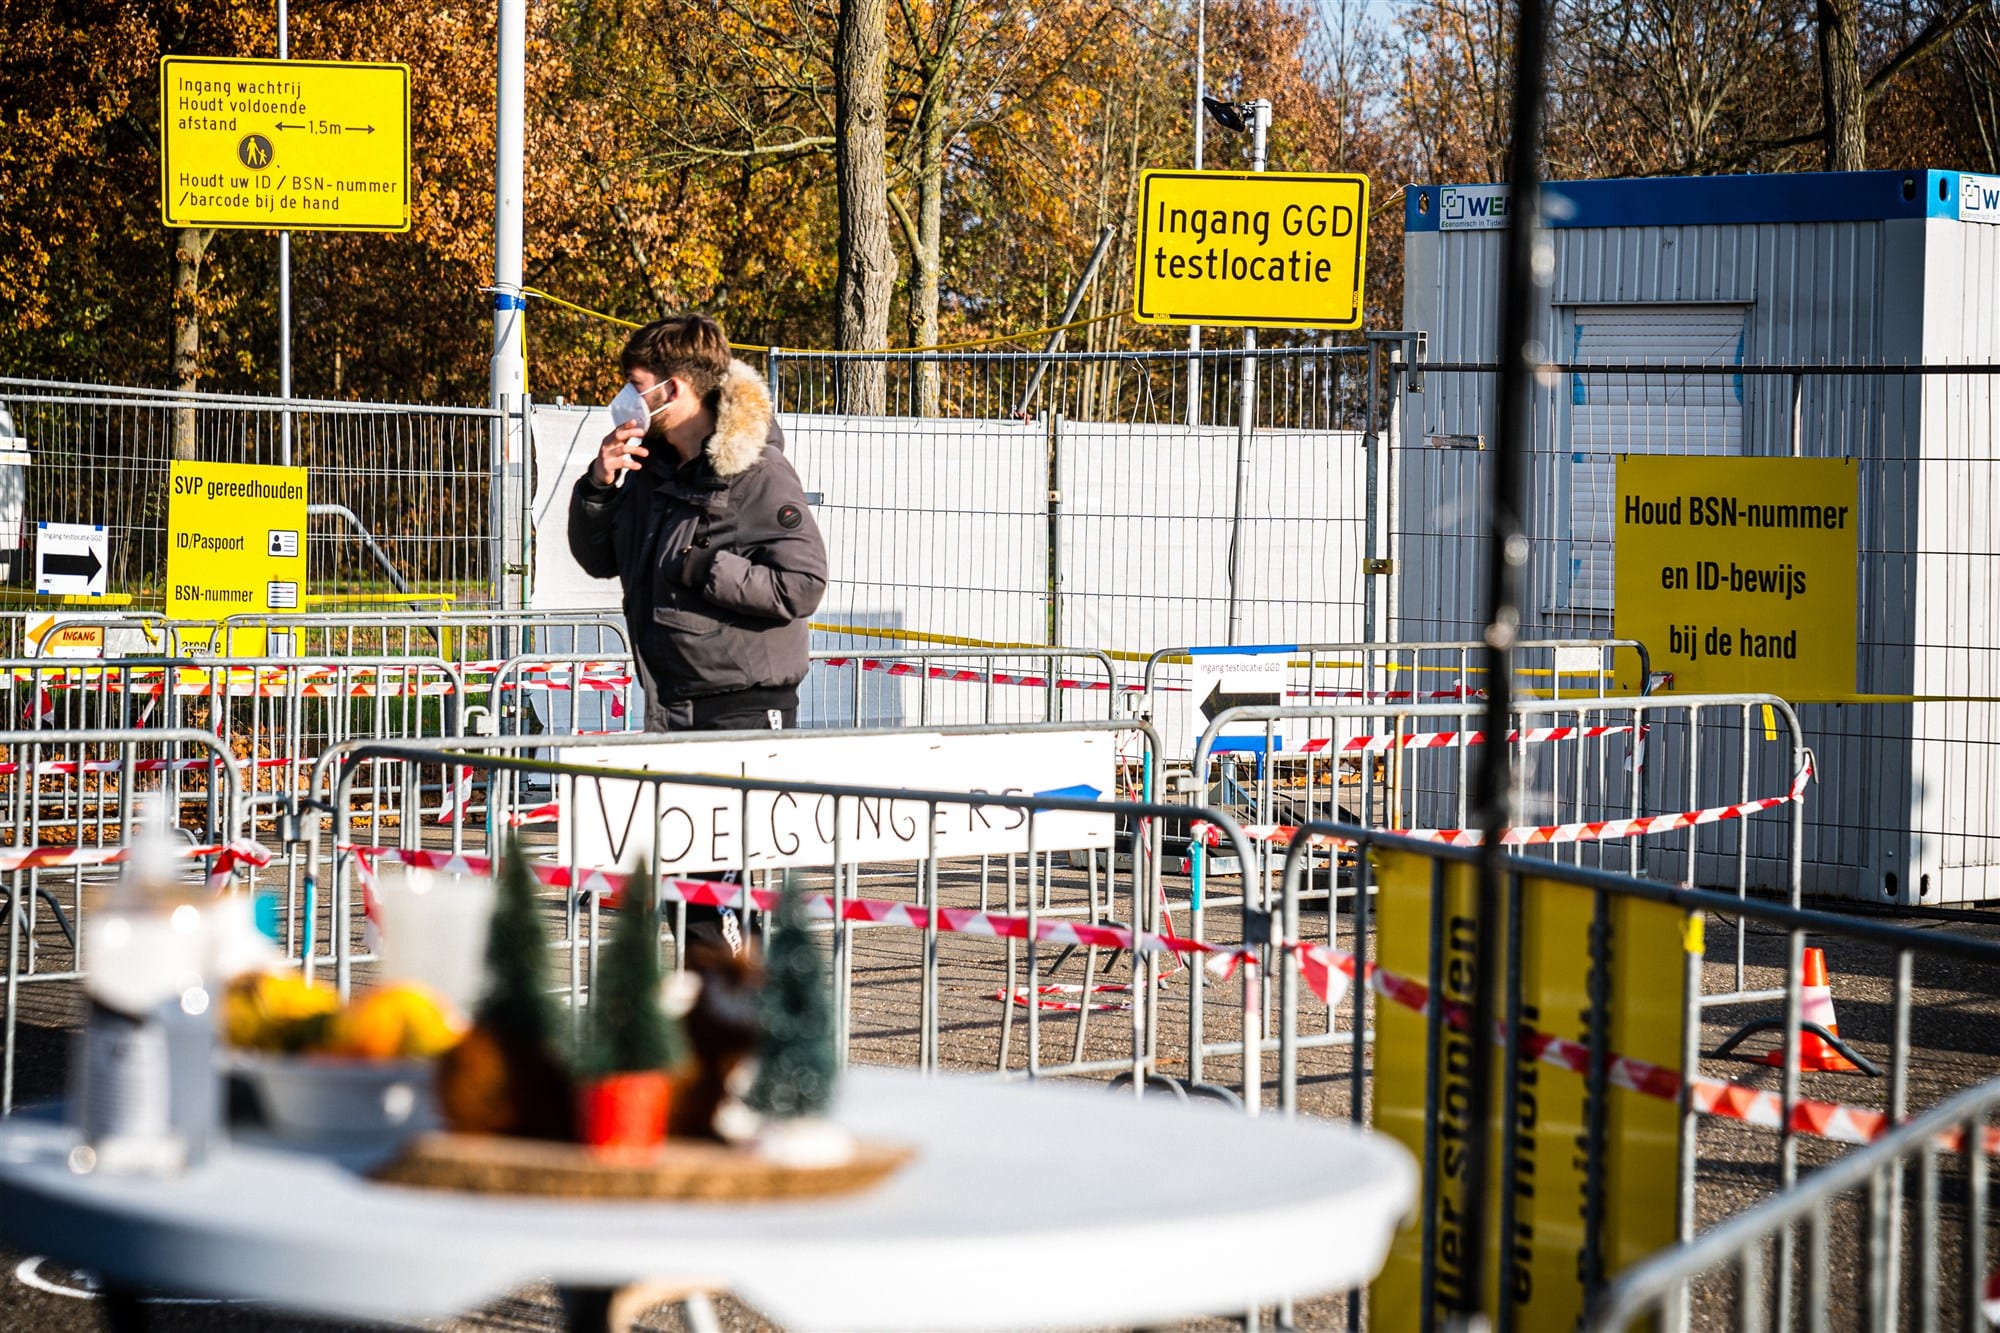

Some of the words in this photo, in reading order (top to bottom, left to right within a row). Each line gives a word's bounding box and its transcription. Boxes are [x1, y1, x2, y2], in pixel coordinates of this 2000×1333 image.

[179, 77, 231, 97] Ingang
[237, 81, 302, 99] wachtrij
[179, 97, 224, 112] Houdt
[230, 99, 307, 115] voldoende
[178, 116, 237, 131] afstand
[179, 173, 224, 188] Houdt
[231, 177, 249, 189] uw
[255, 176, 271, 189] ID
[292, 177, 398, 193] BSN-nummer
[179, 191, 250, 208] /barcode
[255, 193, 275, 213] bij
[280, 194, 296, 209] de
[303, 195, 339, 211] hand
[1158, 201, 1270, 246] Ingang
[1283, 204, 1353, 237] GGD
[1154, 246, 1331, 283] testlocatie
[175, 475, 203, 495] SVP
[208, 479, 303, 500] gereedhouden
[1625, 495, 1681, 525] Houd
[1689, 496, 1849, 529] BSN-nummer
[177, 532, 245, 552] ID/Paspoort
[1662, 566, 1688, 590] en
[1697, 561, 1806, 601] ID-bewijs
[175, 585, 253, 603] BSN-nummer
[62, 631, 96, 641] INGANG
[1670, 625, 1697, 661] bij
[1705, 626, 1732, 657] de
[1740, 628, 1797, 659] hand
[1201, 663, 1224, 674] Ingang
[1226, 663, 1263, 673] testlocatie
[1265, 663, 1280, 672] GGD
